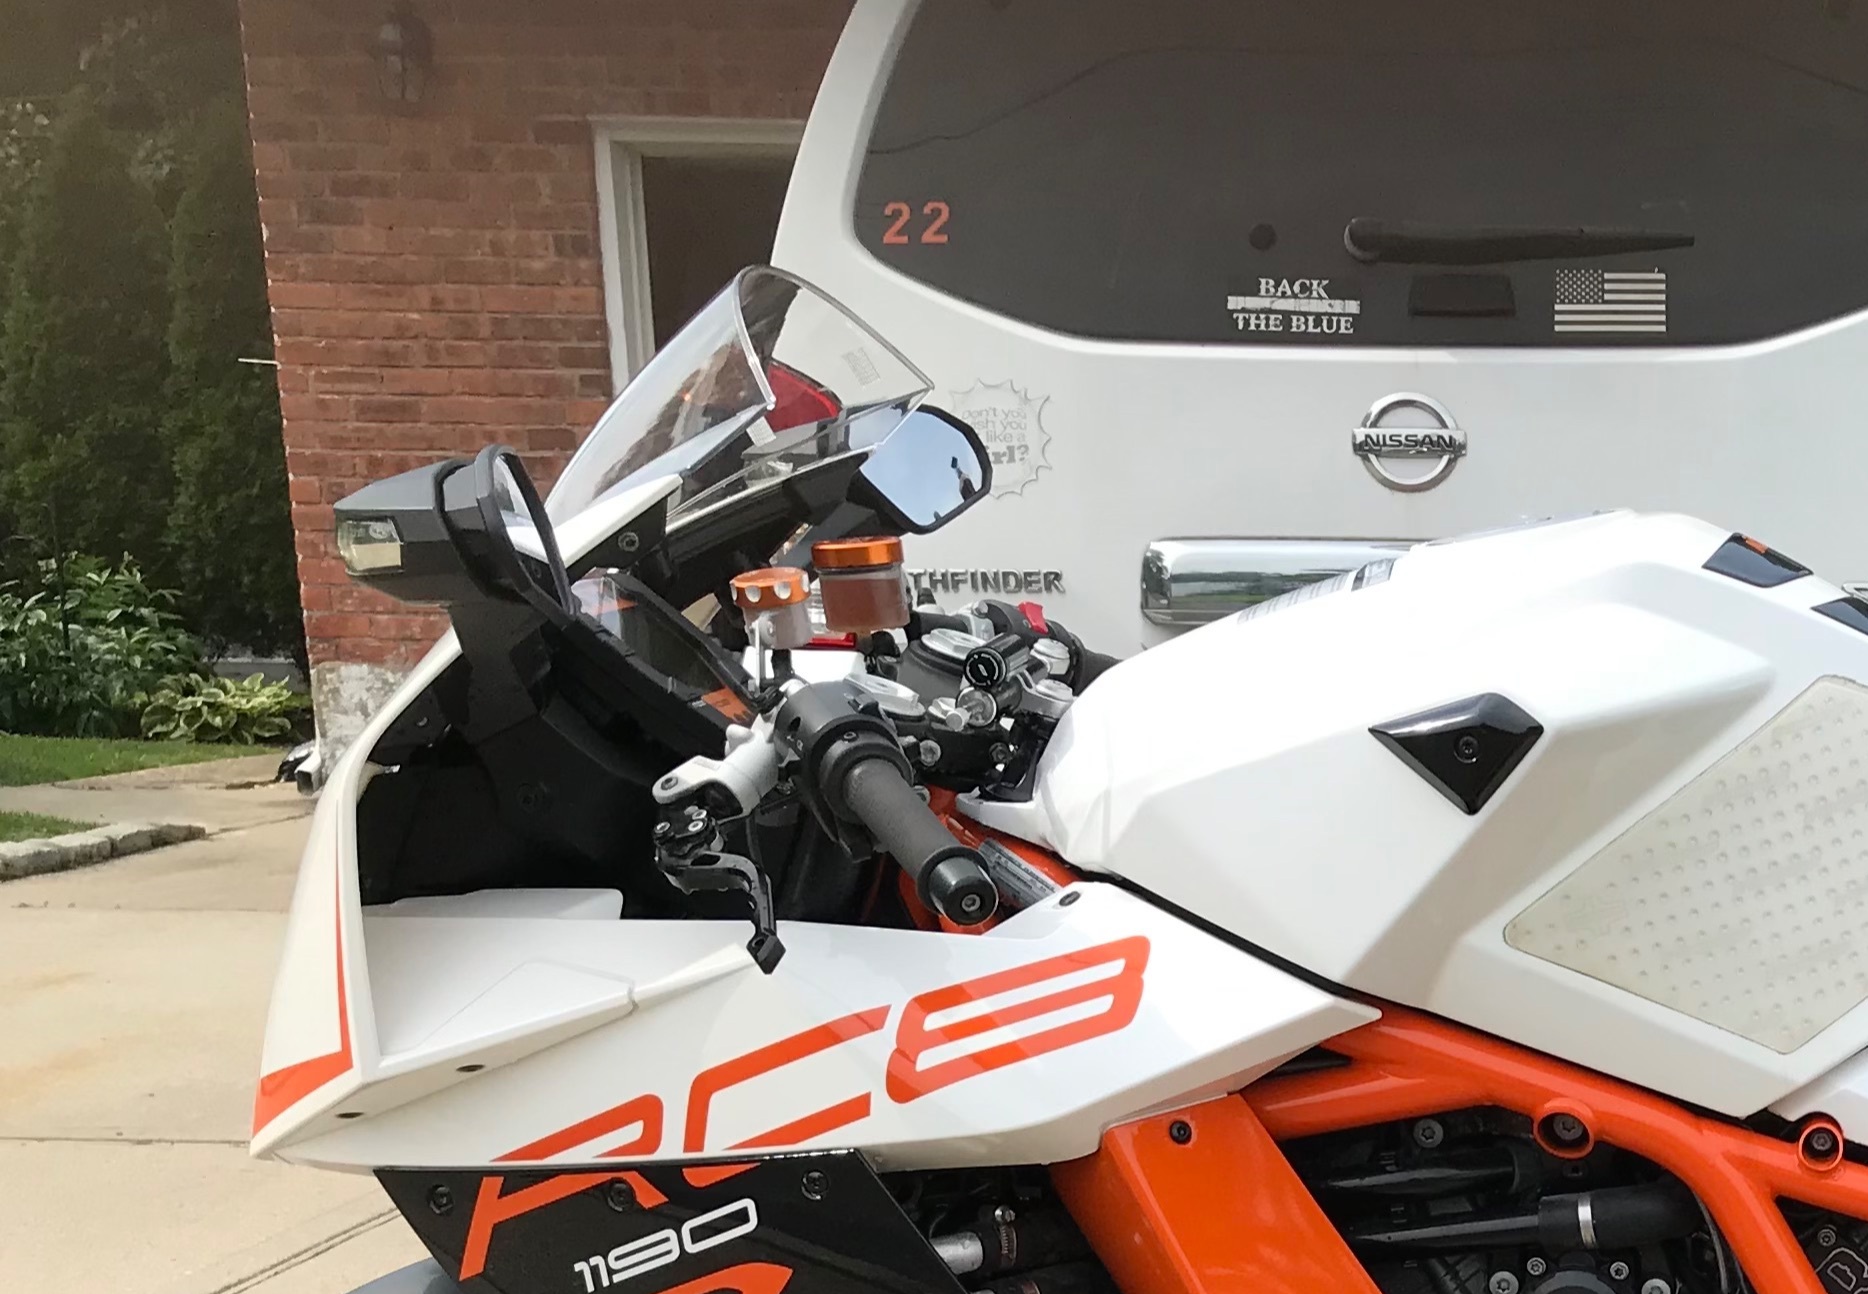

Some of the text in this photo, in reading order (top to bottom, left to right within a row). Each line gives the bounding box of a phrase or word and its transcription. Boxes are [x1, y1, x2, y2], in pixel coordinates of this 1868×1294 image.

[1258, 277, 1330, 300] BACK
[1233, 312, 1355, 334] THE BLUE
[1000, 420, 1027, 434] you
[1363, 433, 1454, 450] NISSAN
[906, 568, 1066, 594] THFINDER
[574, 1198, 758, 1293] 1190
